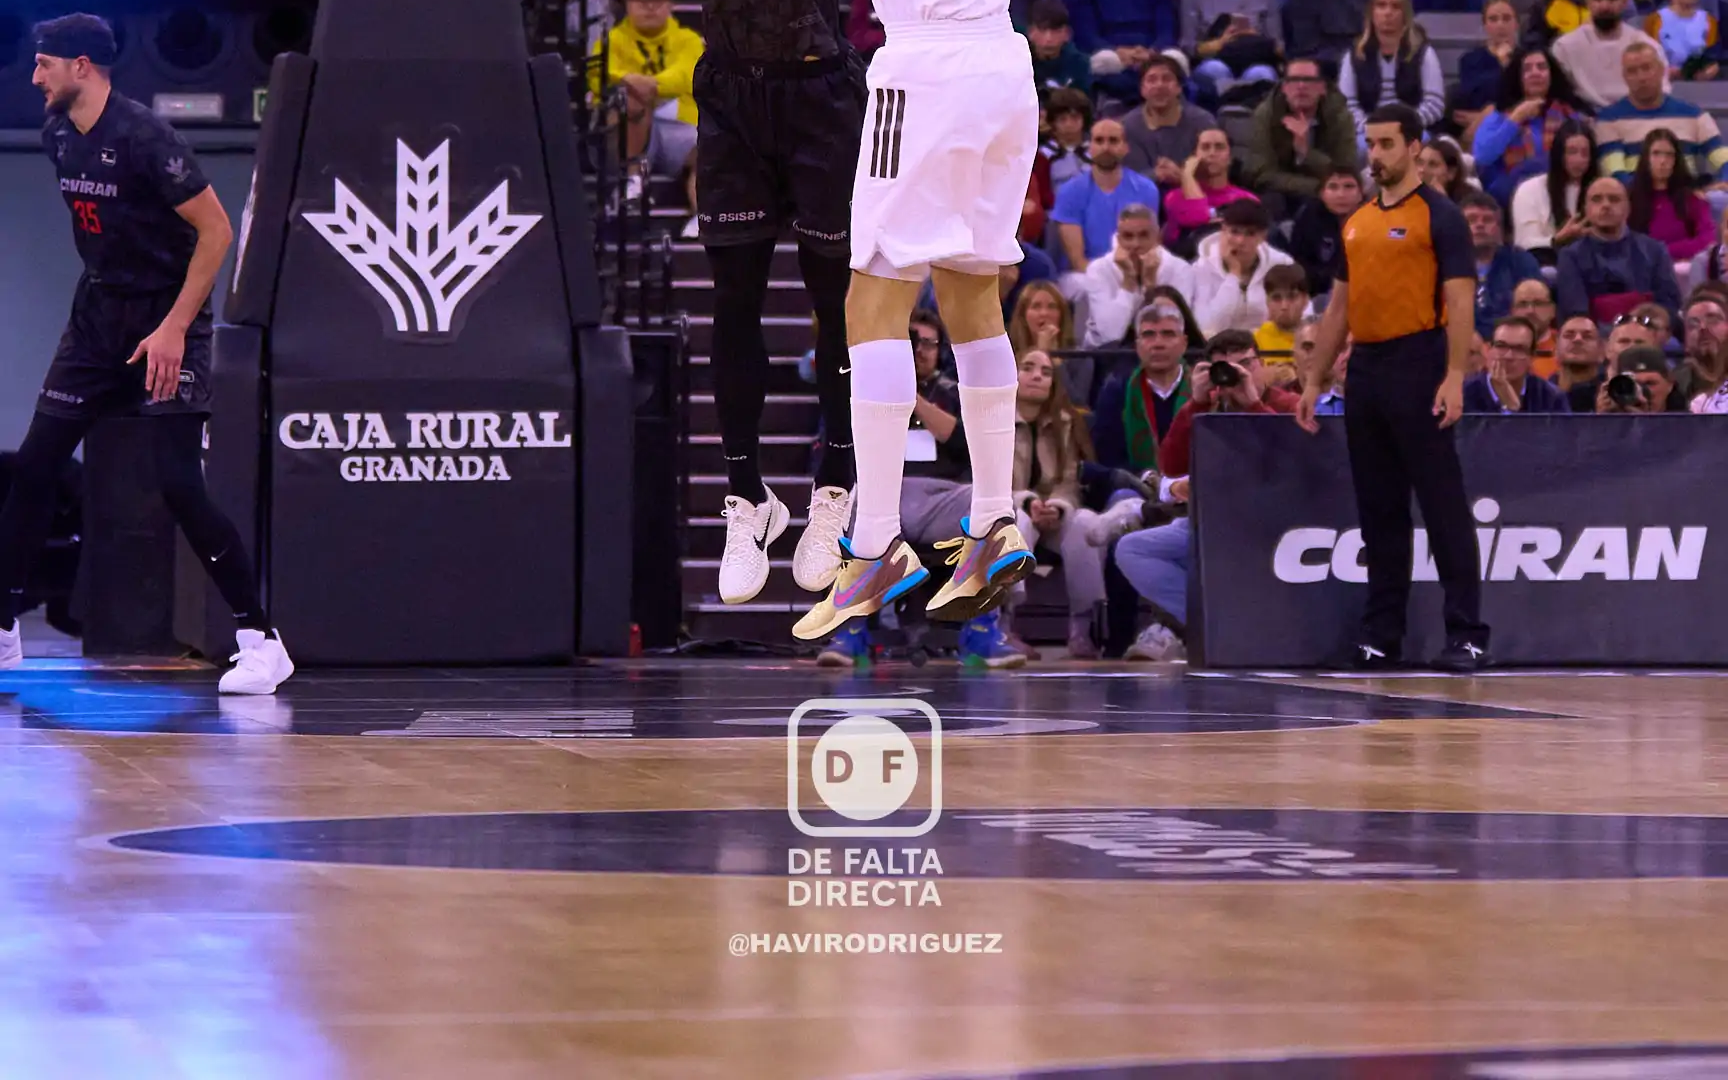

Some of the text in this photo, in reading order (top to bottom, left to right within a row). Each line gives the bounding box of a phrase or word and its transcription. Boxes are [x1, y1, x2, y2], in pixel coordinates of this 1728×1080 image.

[73, 200, 102, 234] 35
[278, 411, 572, 452] CAJA RURAL
[340, 456, 512, 483] GRANADA
